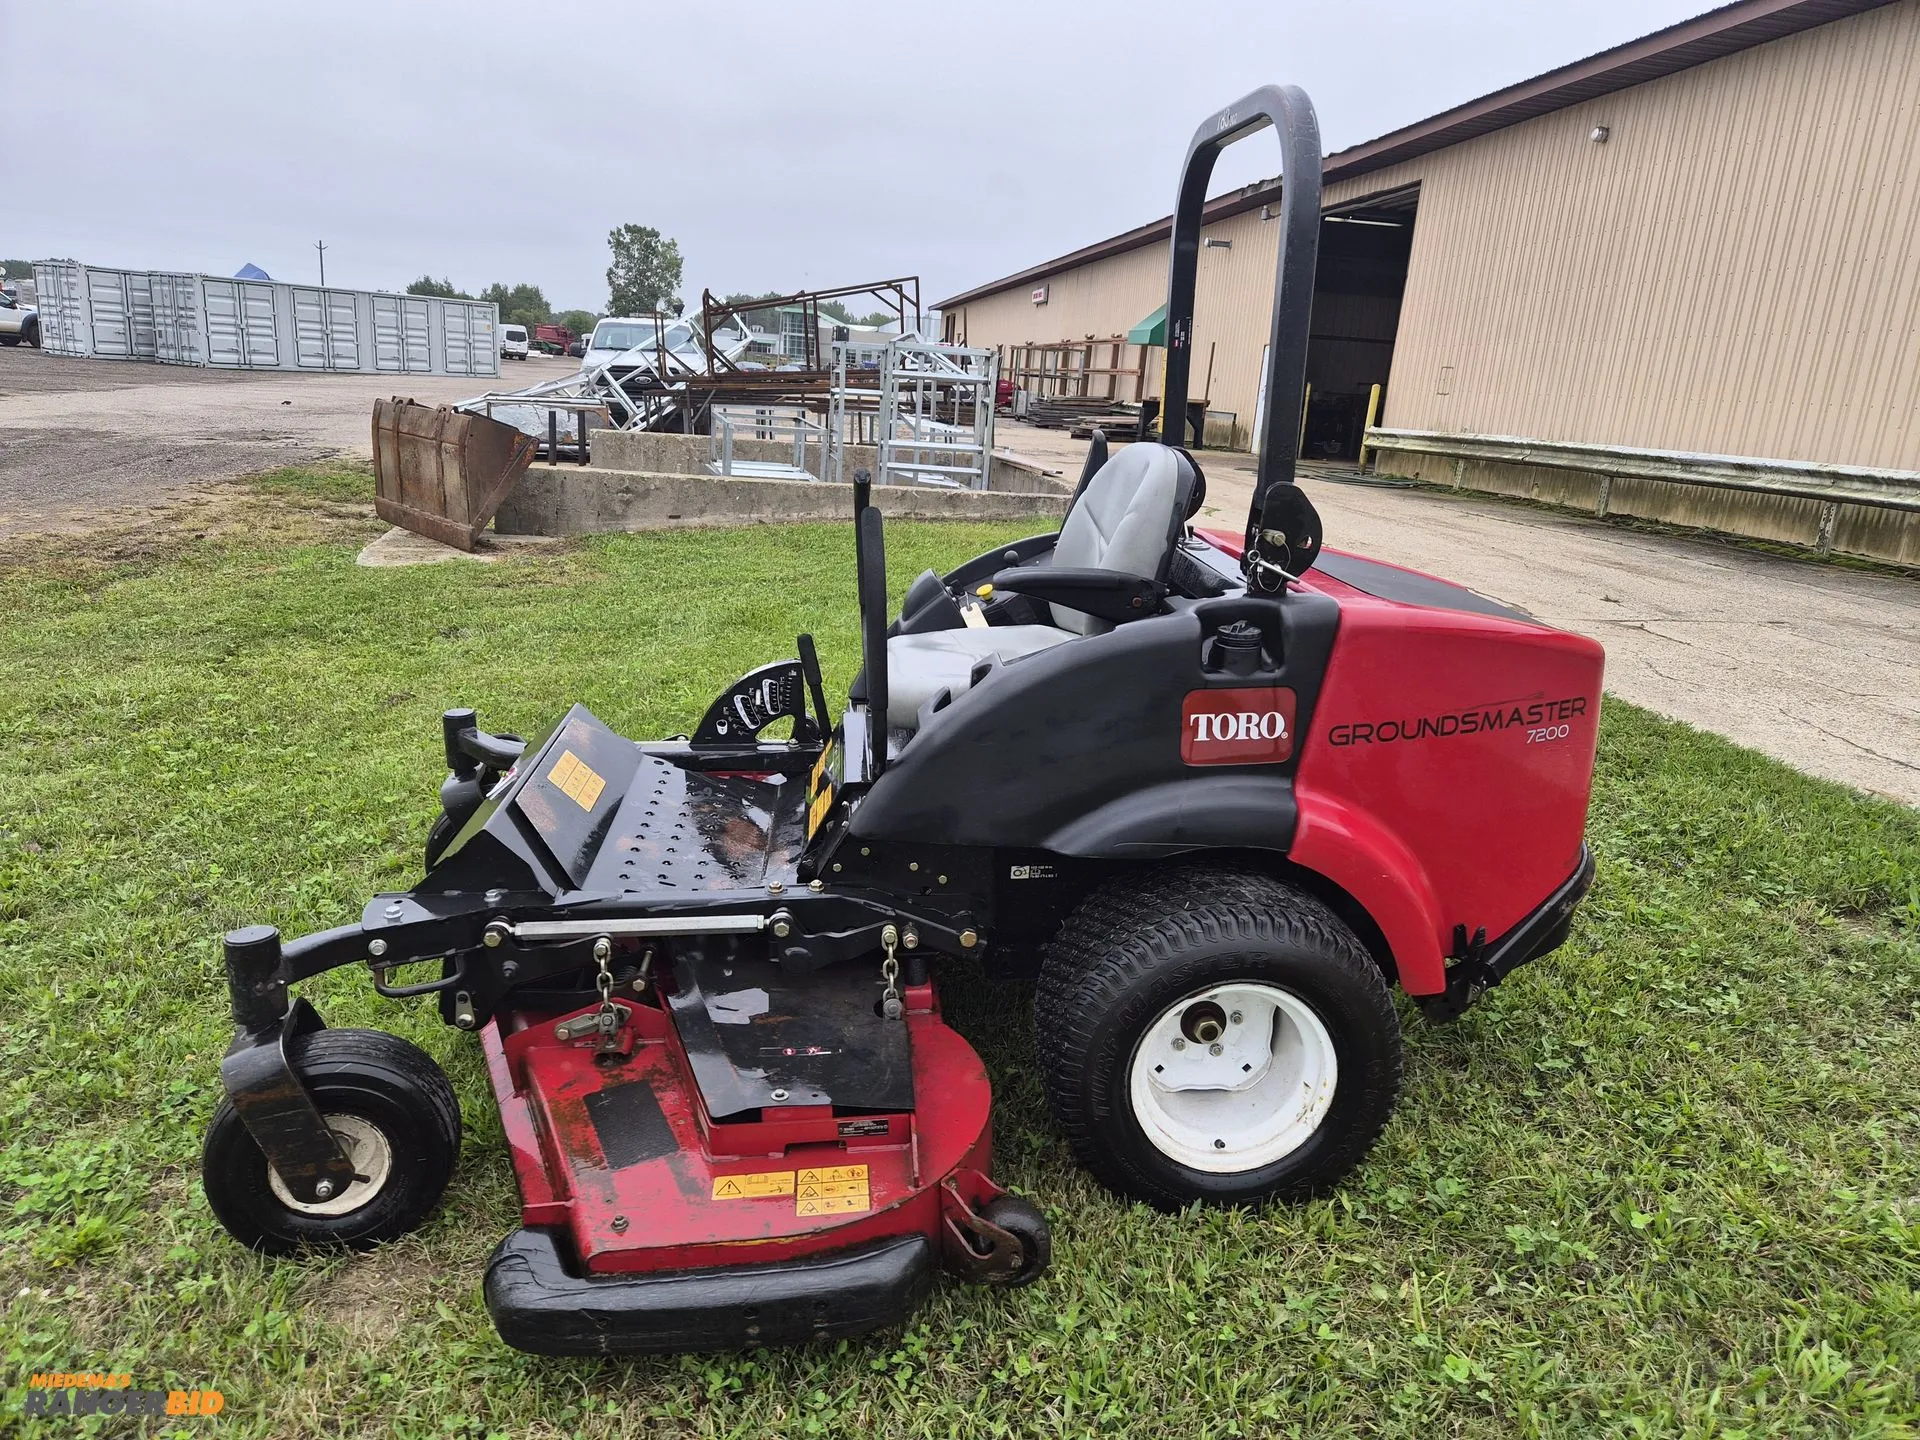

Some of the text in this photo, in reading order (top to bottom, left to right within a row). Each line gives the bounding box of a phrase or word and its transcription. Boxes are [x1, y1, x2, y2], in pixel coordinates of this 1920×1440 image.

[1328, 697, 1587, 747] GROUNDSMASTER
[1526, 724, 1569, 744] 7200
[1116, 951, 1271, 1031] MASTER
